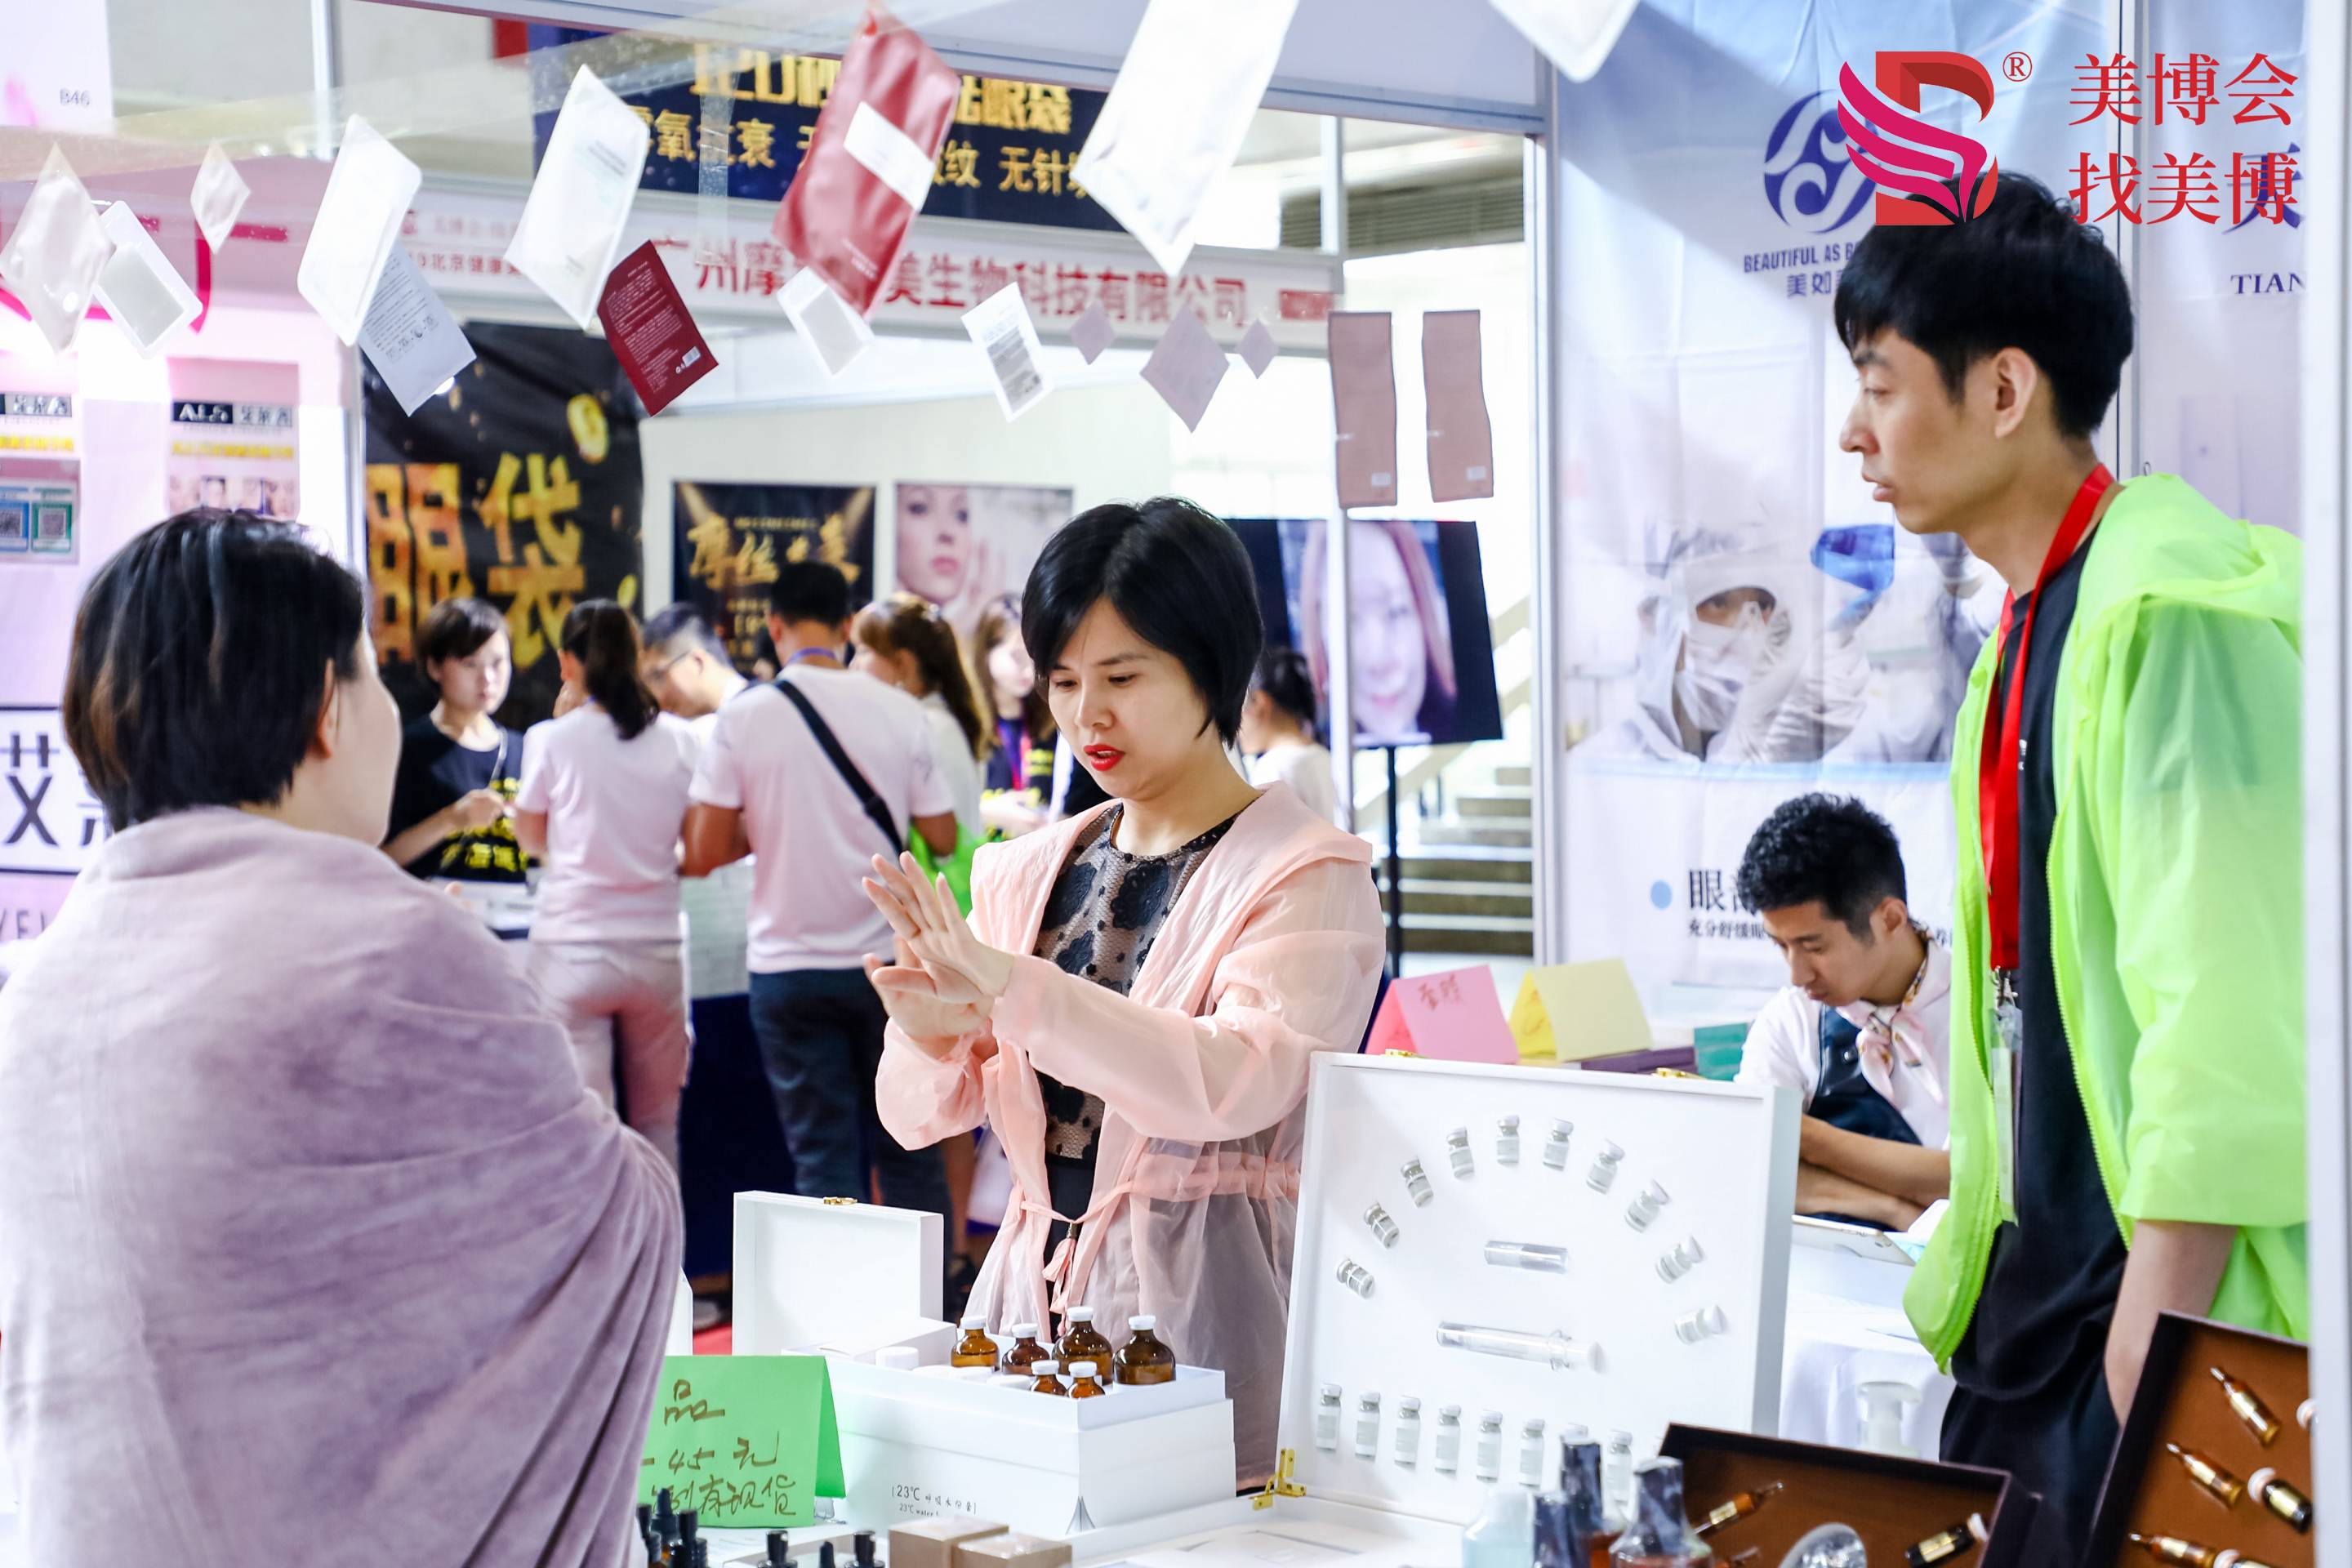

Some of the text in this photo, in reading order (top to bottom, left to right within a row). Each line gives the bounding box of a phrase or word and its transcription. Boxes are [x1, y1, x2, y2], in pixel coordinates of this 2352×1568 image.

[1744, 247, 1819, 273] BEAUTIFUL
[1824, 243, 1841, 262] AS
[1787, 270, 1843, 298] 美如
